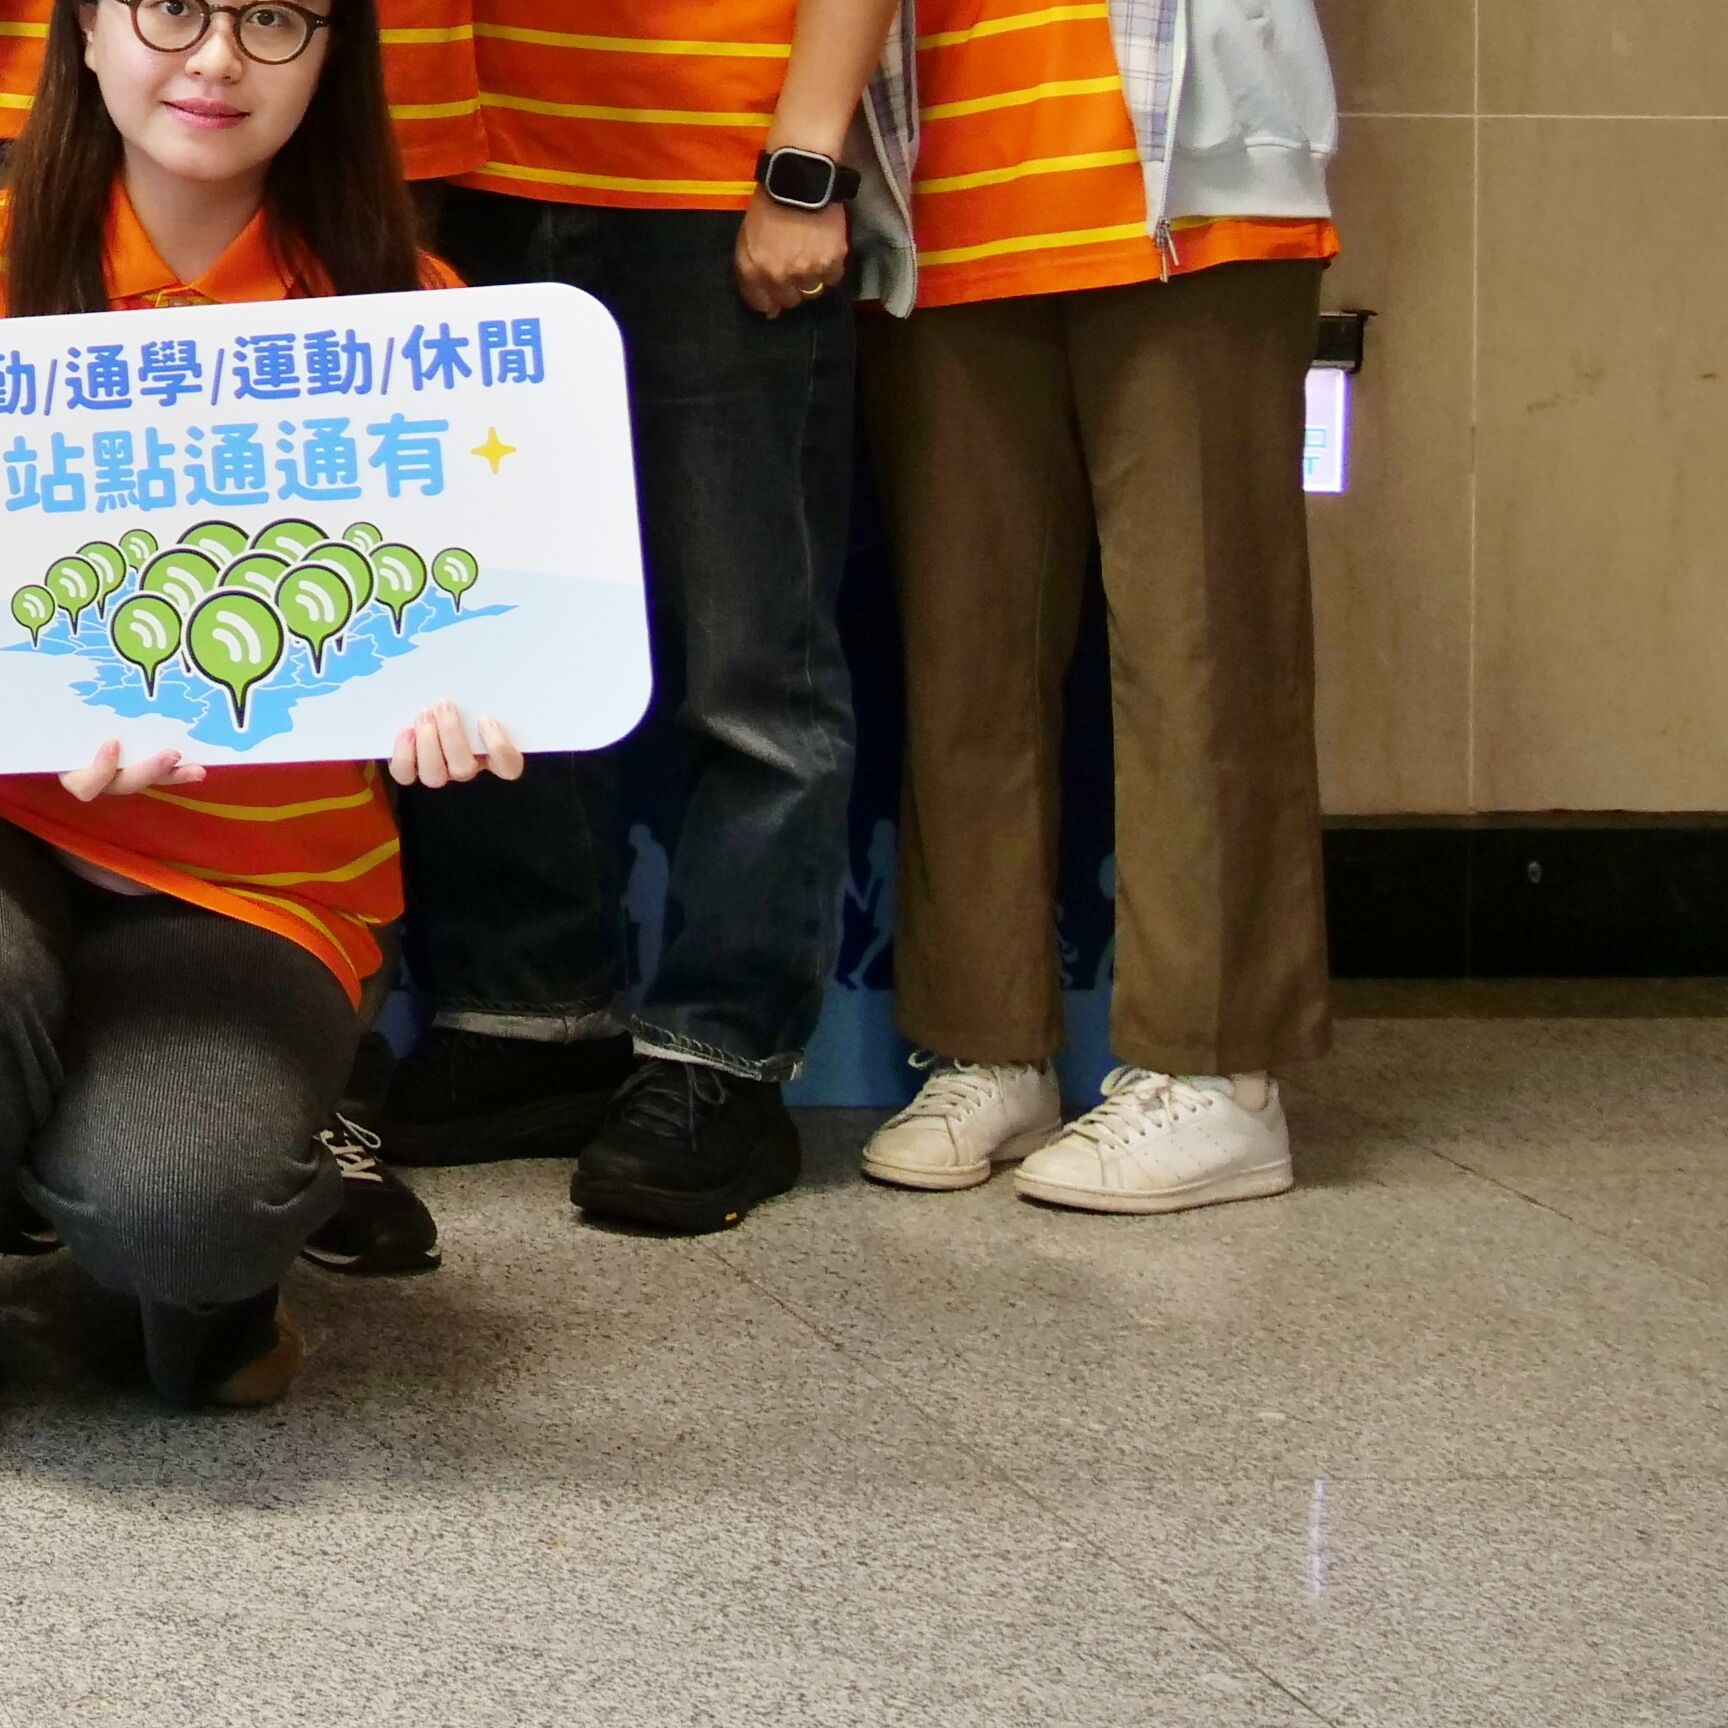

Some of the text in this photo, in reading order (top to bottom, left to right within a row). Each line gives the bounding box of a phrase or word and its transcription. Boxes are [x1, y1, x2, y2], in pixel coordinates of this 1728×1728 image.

[3, 411, 450, 515] 站點通通有
